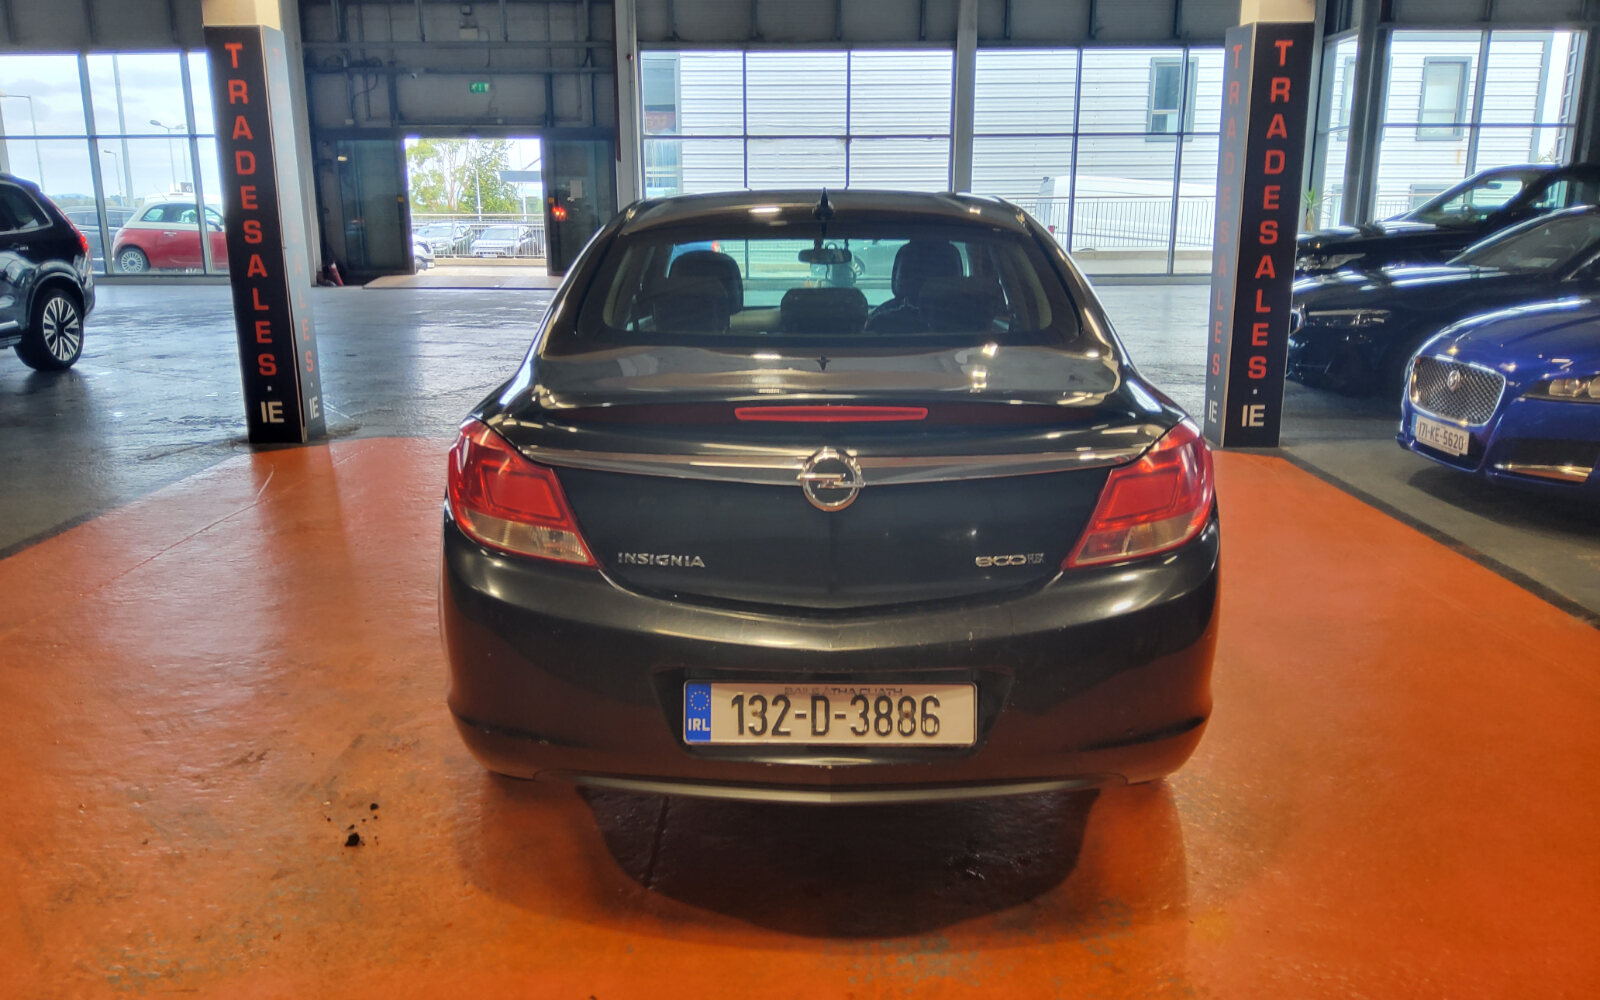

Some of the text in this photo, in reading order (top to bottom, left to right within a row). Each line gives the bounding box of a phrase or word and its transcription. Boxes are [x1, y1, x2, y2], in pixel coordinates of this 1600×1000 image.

[1419, 422, 1464, 451] 171-KE-5620
[617, 552, 706, 568] INSIGNIA
[687, 717, 711, 732] IRL
[731, 694, 941, 738] 132-D-3886
